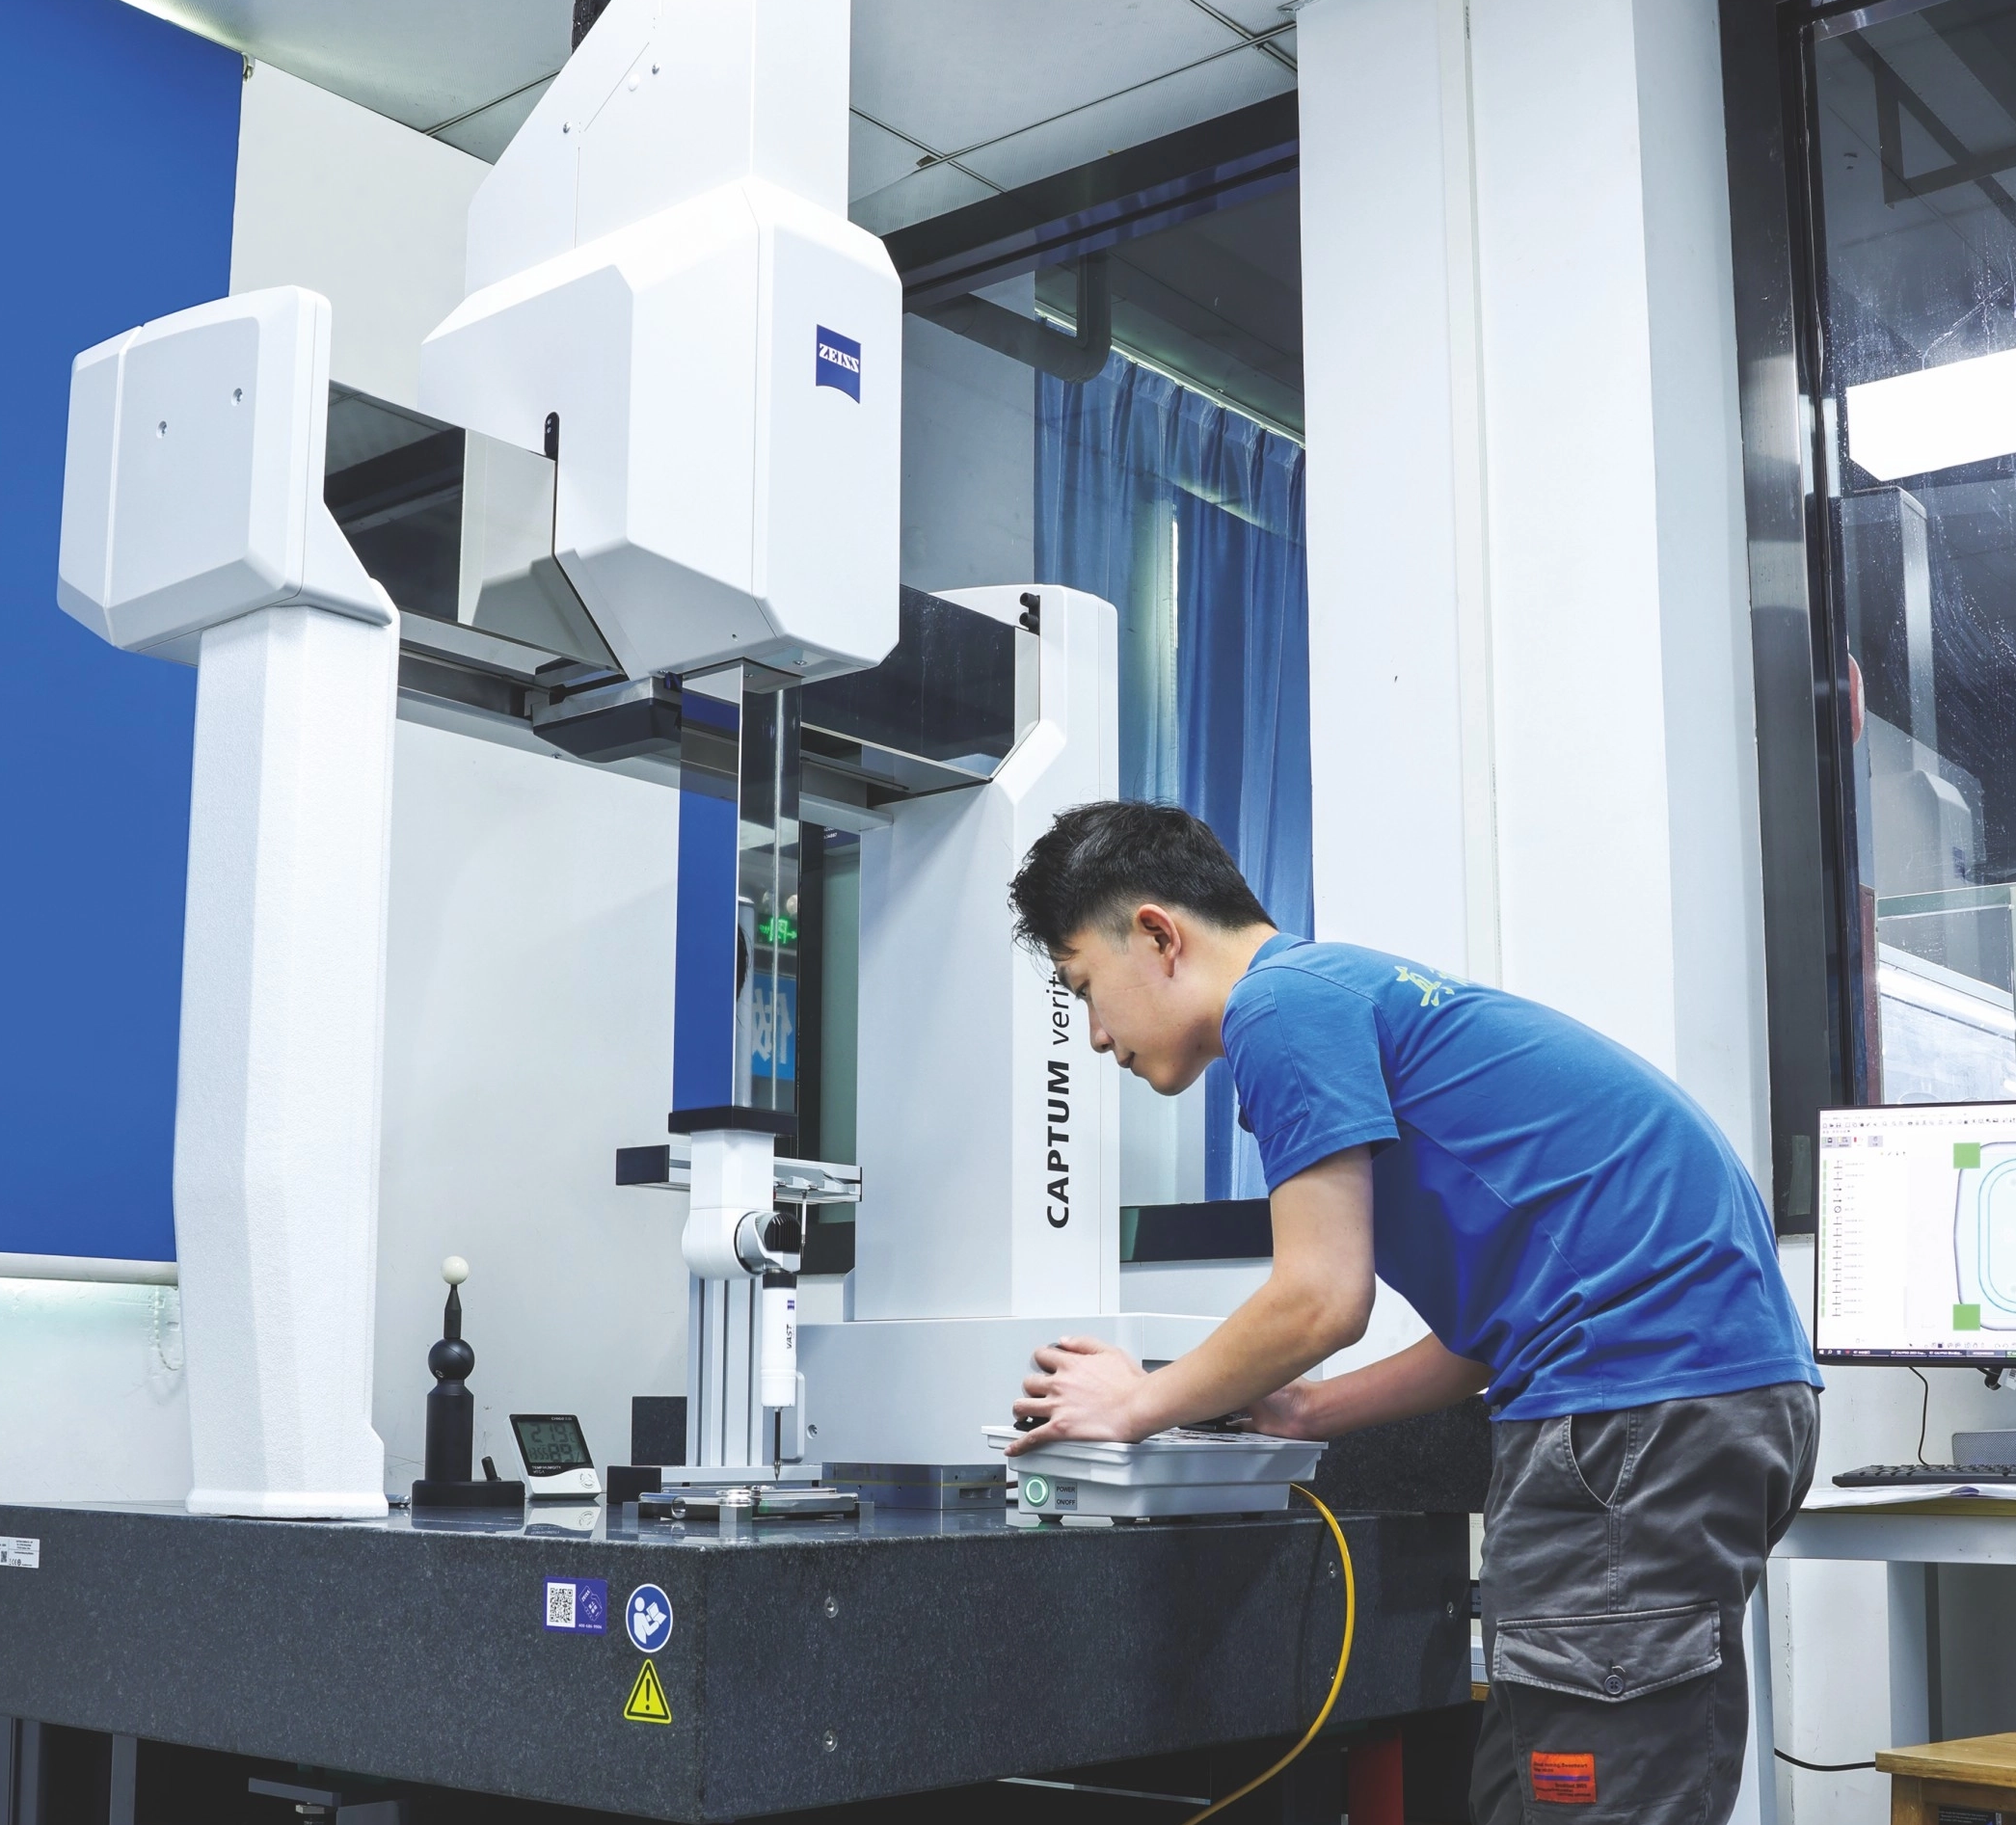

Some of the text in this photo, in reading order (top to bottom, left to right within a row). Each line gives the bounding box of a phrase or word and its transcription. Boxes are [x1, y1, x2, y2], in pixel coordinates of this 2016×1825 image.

[819, 343, 859, 373] ZEISS
[1046, 971, 1070, 1228] CAPTUM verit
